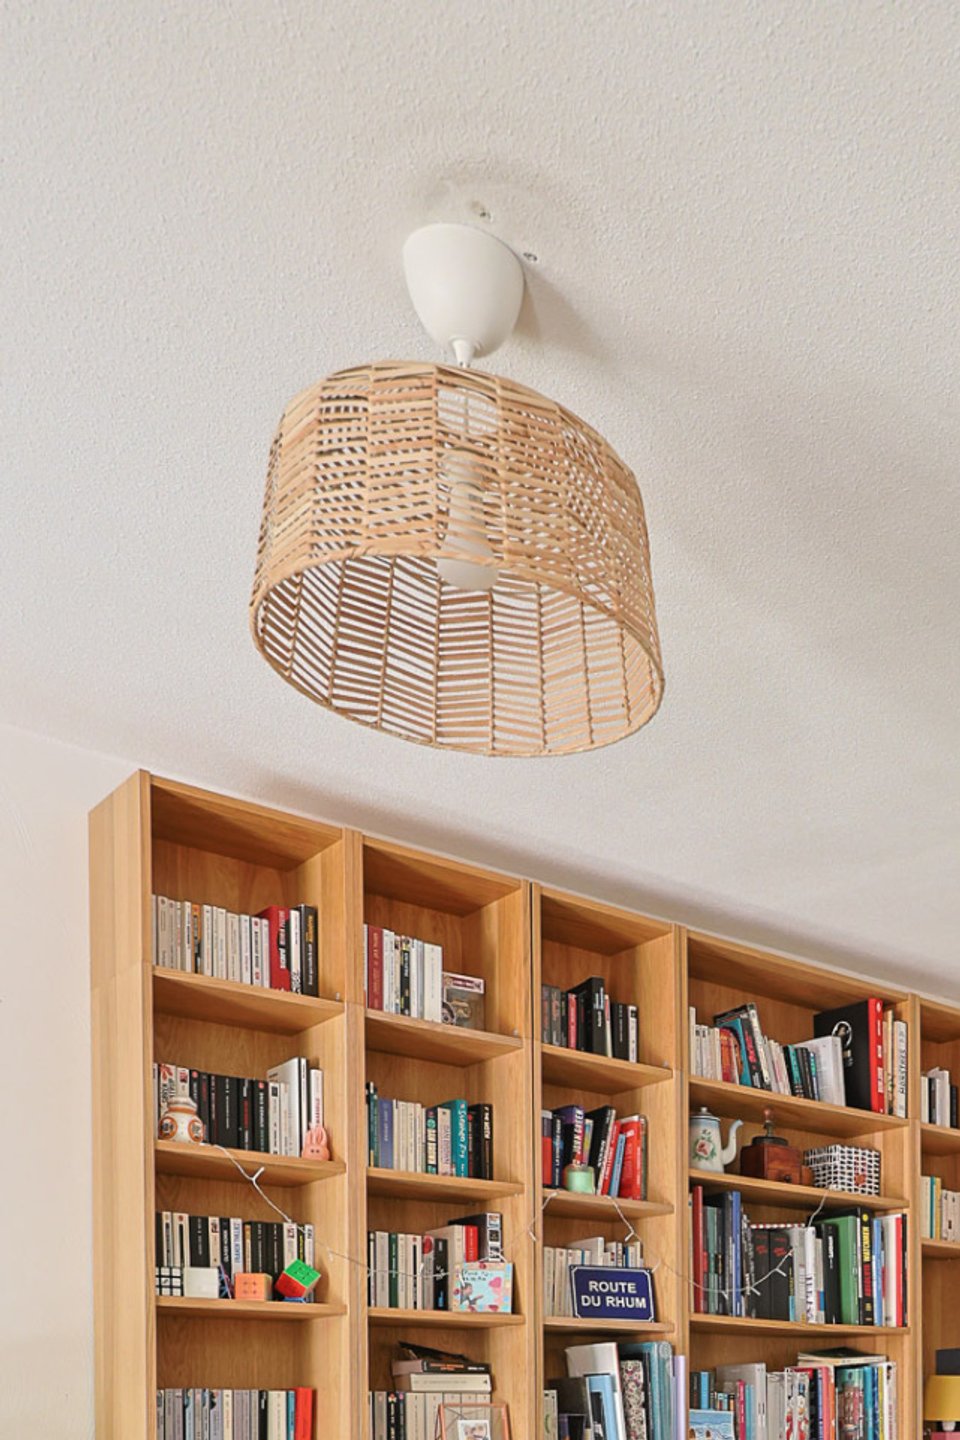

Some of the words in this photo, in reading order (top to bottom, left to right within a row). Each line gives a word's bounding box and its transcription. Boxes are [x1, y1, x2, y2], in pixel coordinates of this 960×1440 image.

[588, 1281, 637, 1294] ROUTE
[581, 1295, 601, 1307] DU
[606, 1296, 647, 1309] RHUM
